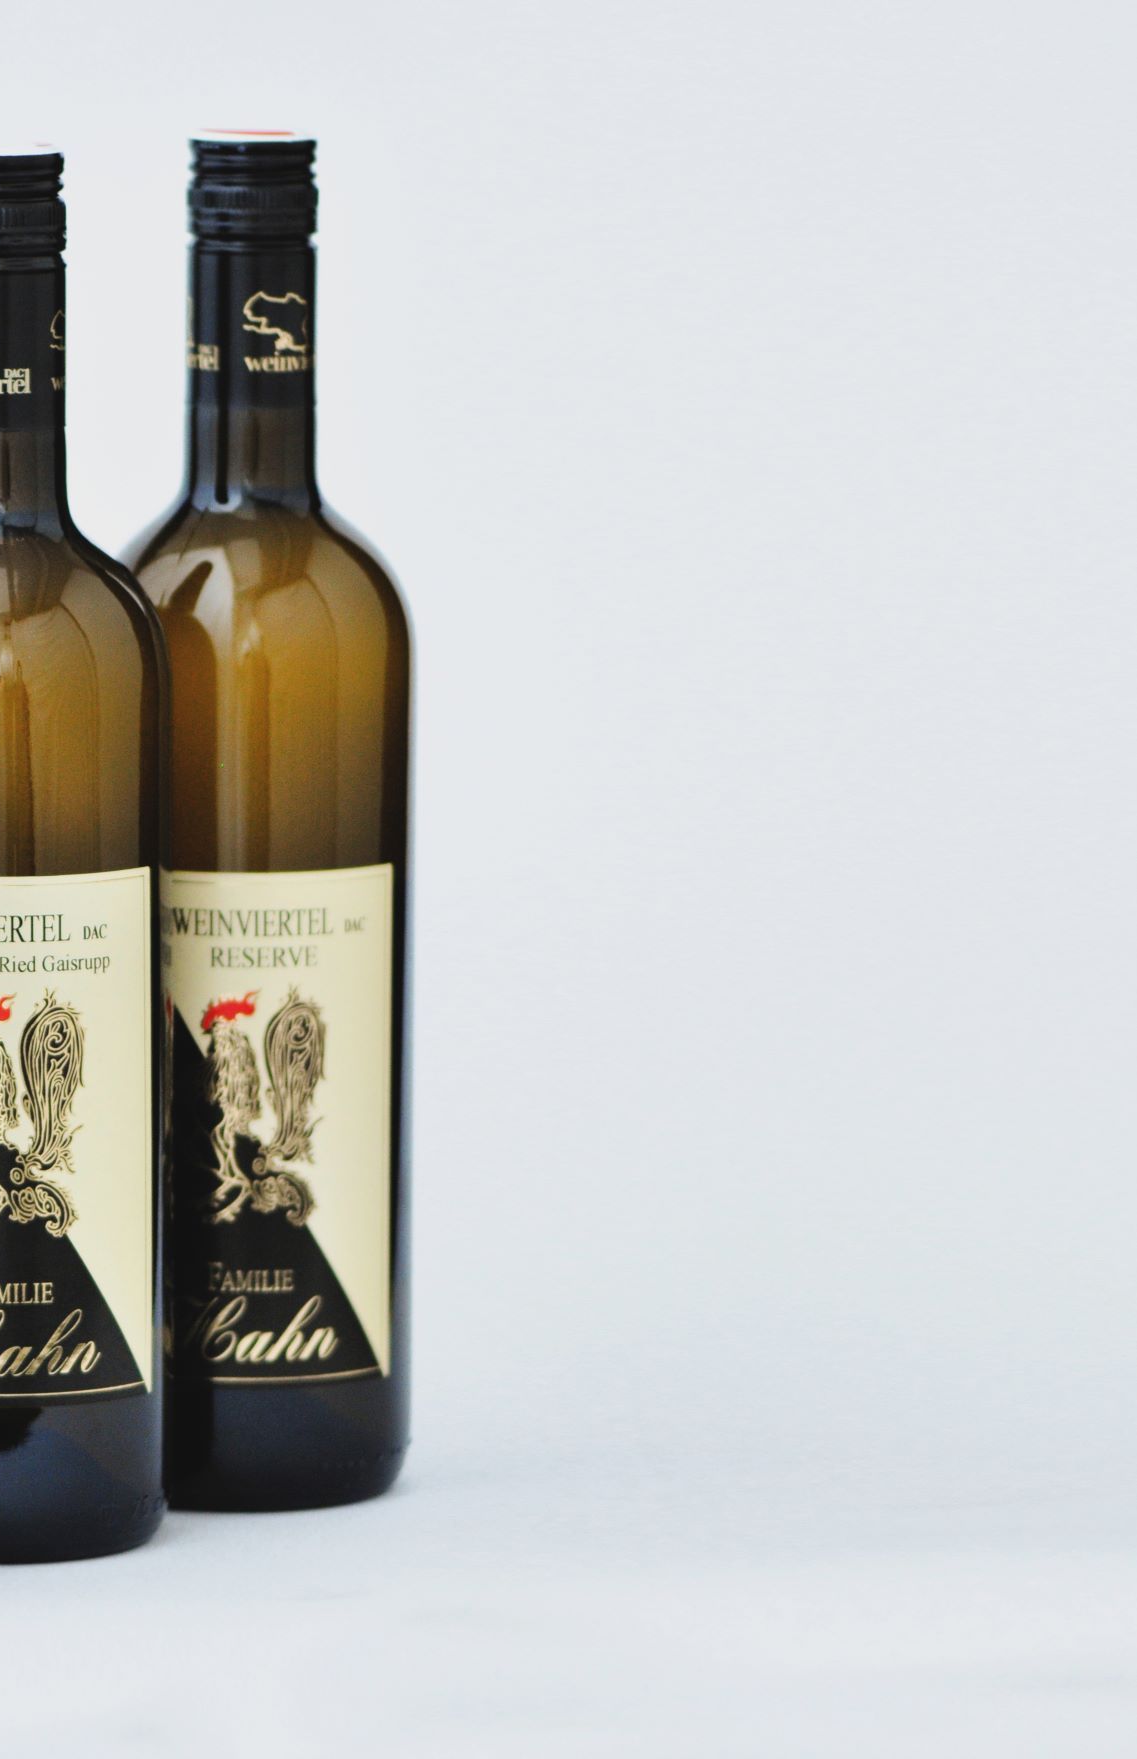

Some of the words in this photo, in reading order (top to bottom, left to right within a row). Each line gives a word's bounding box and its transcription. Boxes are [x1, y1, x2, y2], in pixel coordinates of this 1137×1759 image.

[3, 368, 24, 379] DAC
[83, 923, 107, 940] DAC
[171, 906, 334, 937] WEINVIERTEL
[344, 915, 365, 933] DAC
[42, 954, 110, 974] Gaisrupp
[210, 945, 318, 968] RESERVE
